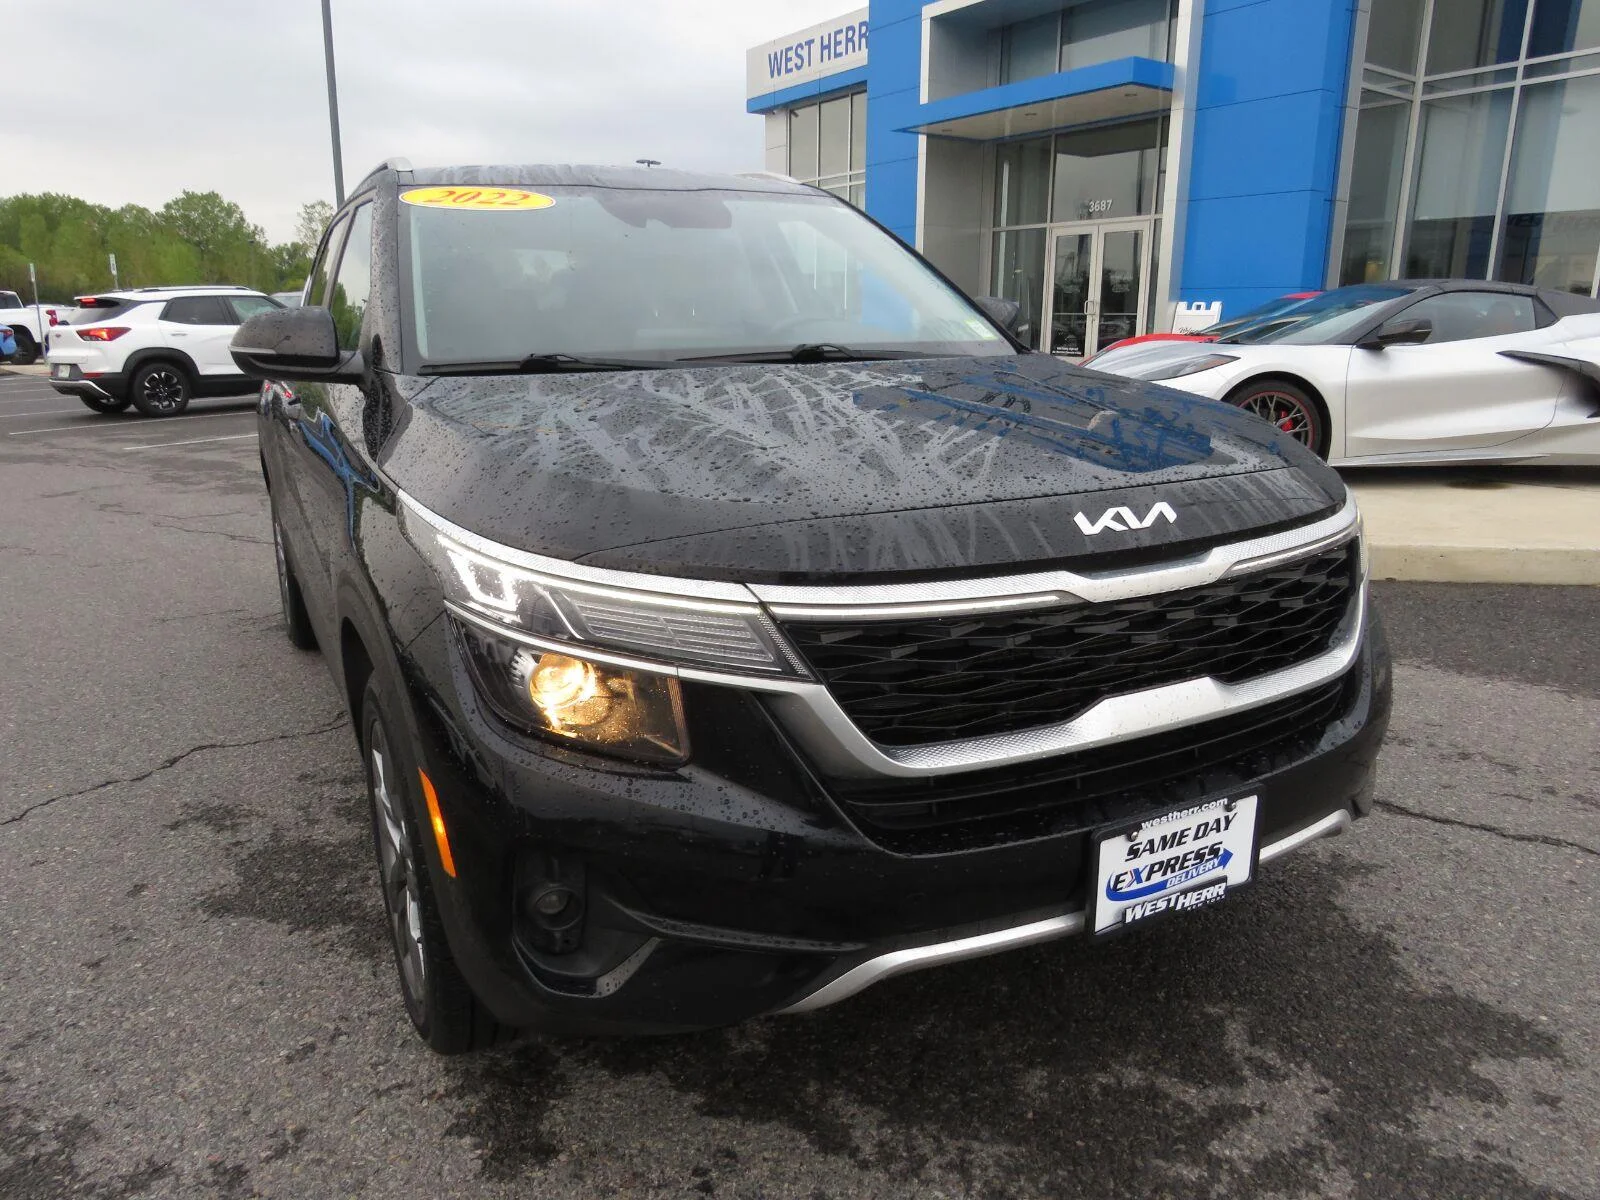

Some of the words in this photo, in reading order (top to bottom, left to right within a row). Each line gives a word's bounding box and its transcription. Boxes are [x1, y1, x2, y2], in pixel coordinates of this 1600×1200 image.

[768, 38, 815, 79] WEST
[820, 20, 869, 63] HERR
[423, 190, 530, 206] 2022
[1088, 199, 1113, 213] 3687
[1073, 501, 1177, 536] KIA
[1125, 827, 1191, 862] SAME
[1192, 812, 1237, 842] DAY
[1112, 841, 1223, 891] EXPRESS
[1166, 858, 1221, 888] DELIVERY
